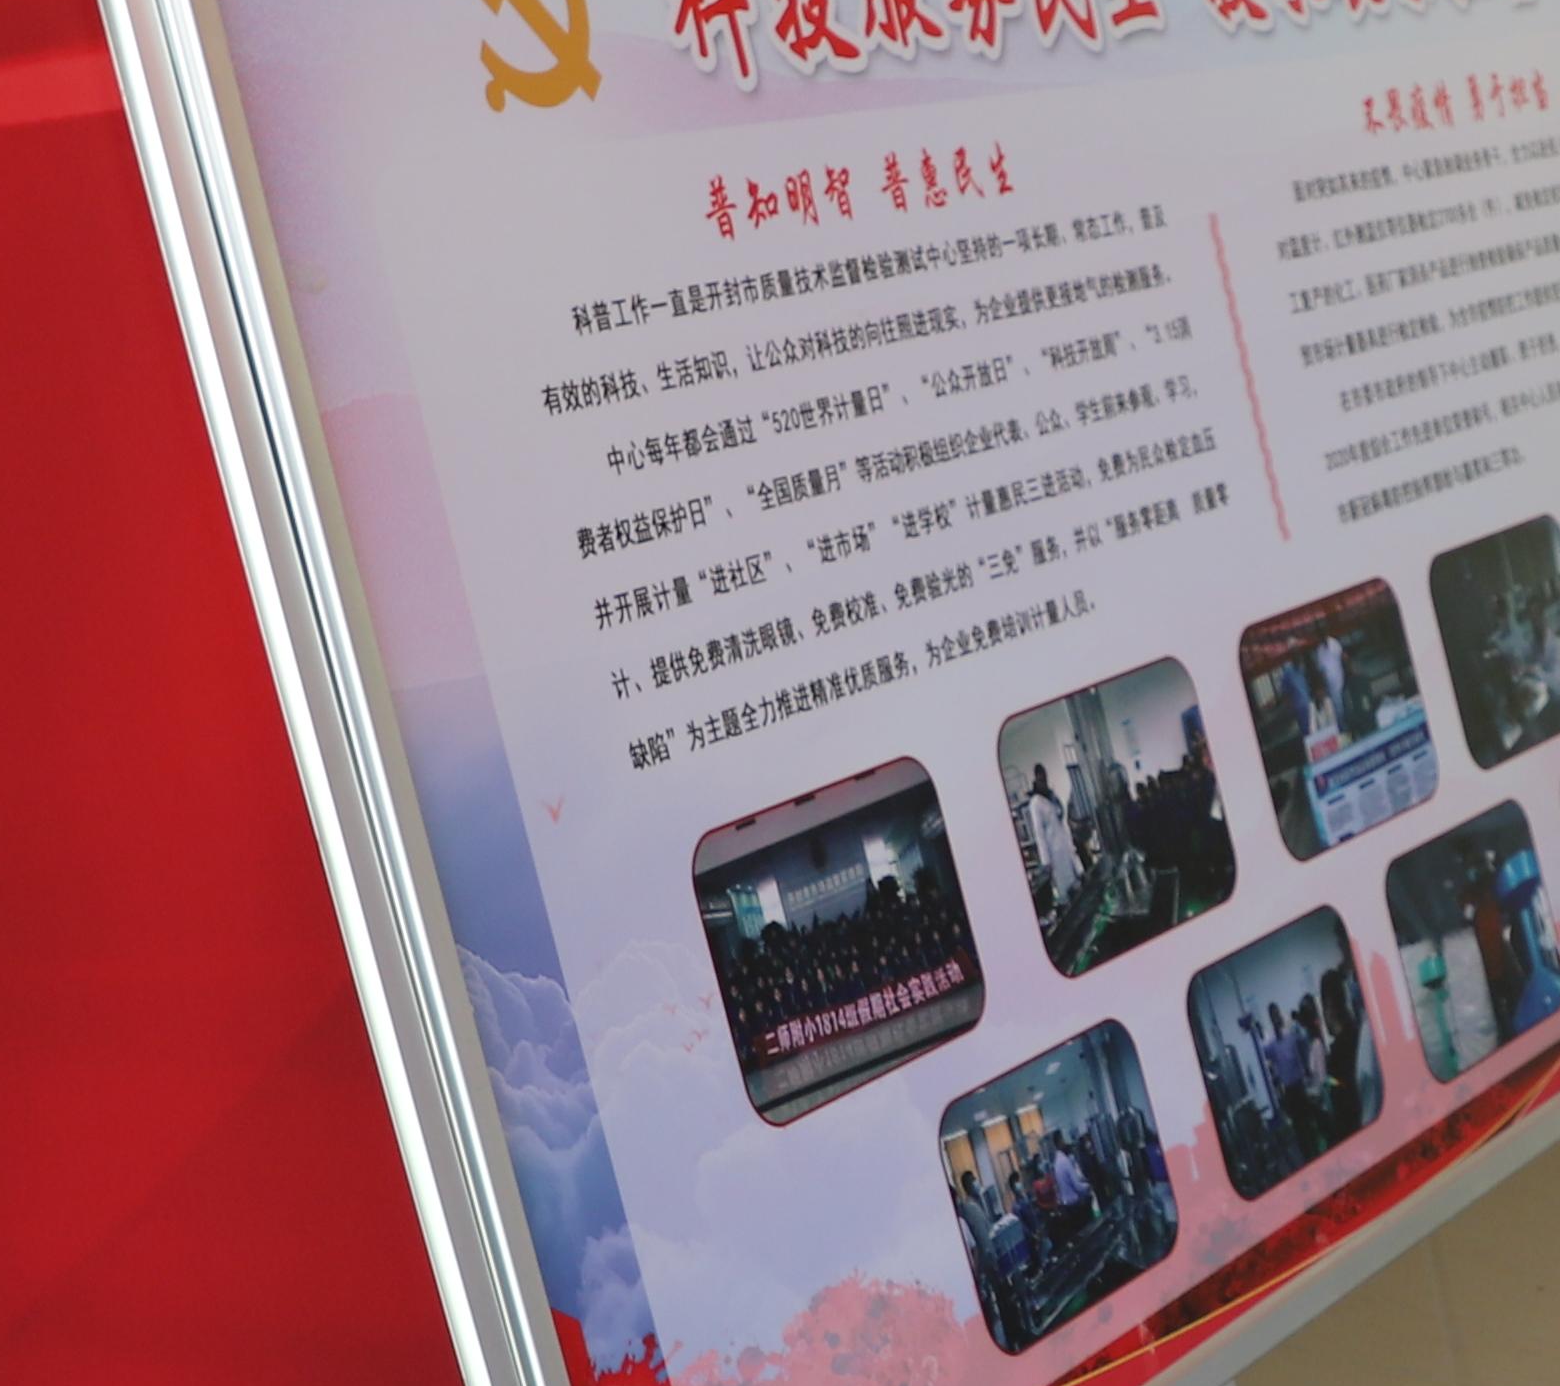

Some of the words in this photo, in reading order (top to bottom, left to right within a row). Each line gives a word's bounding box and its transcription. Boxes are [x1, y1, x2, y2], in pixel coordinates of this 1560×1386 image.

[706, 165, 853, 241] 普知明智
[881, 142, 1015, 215] 普惠民生
